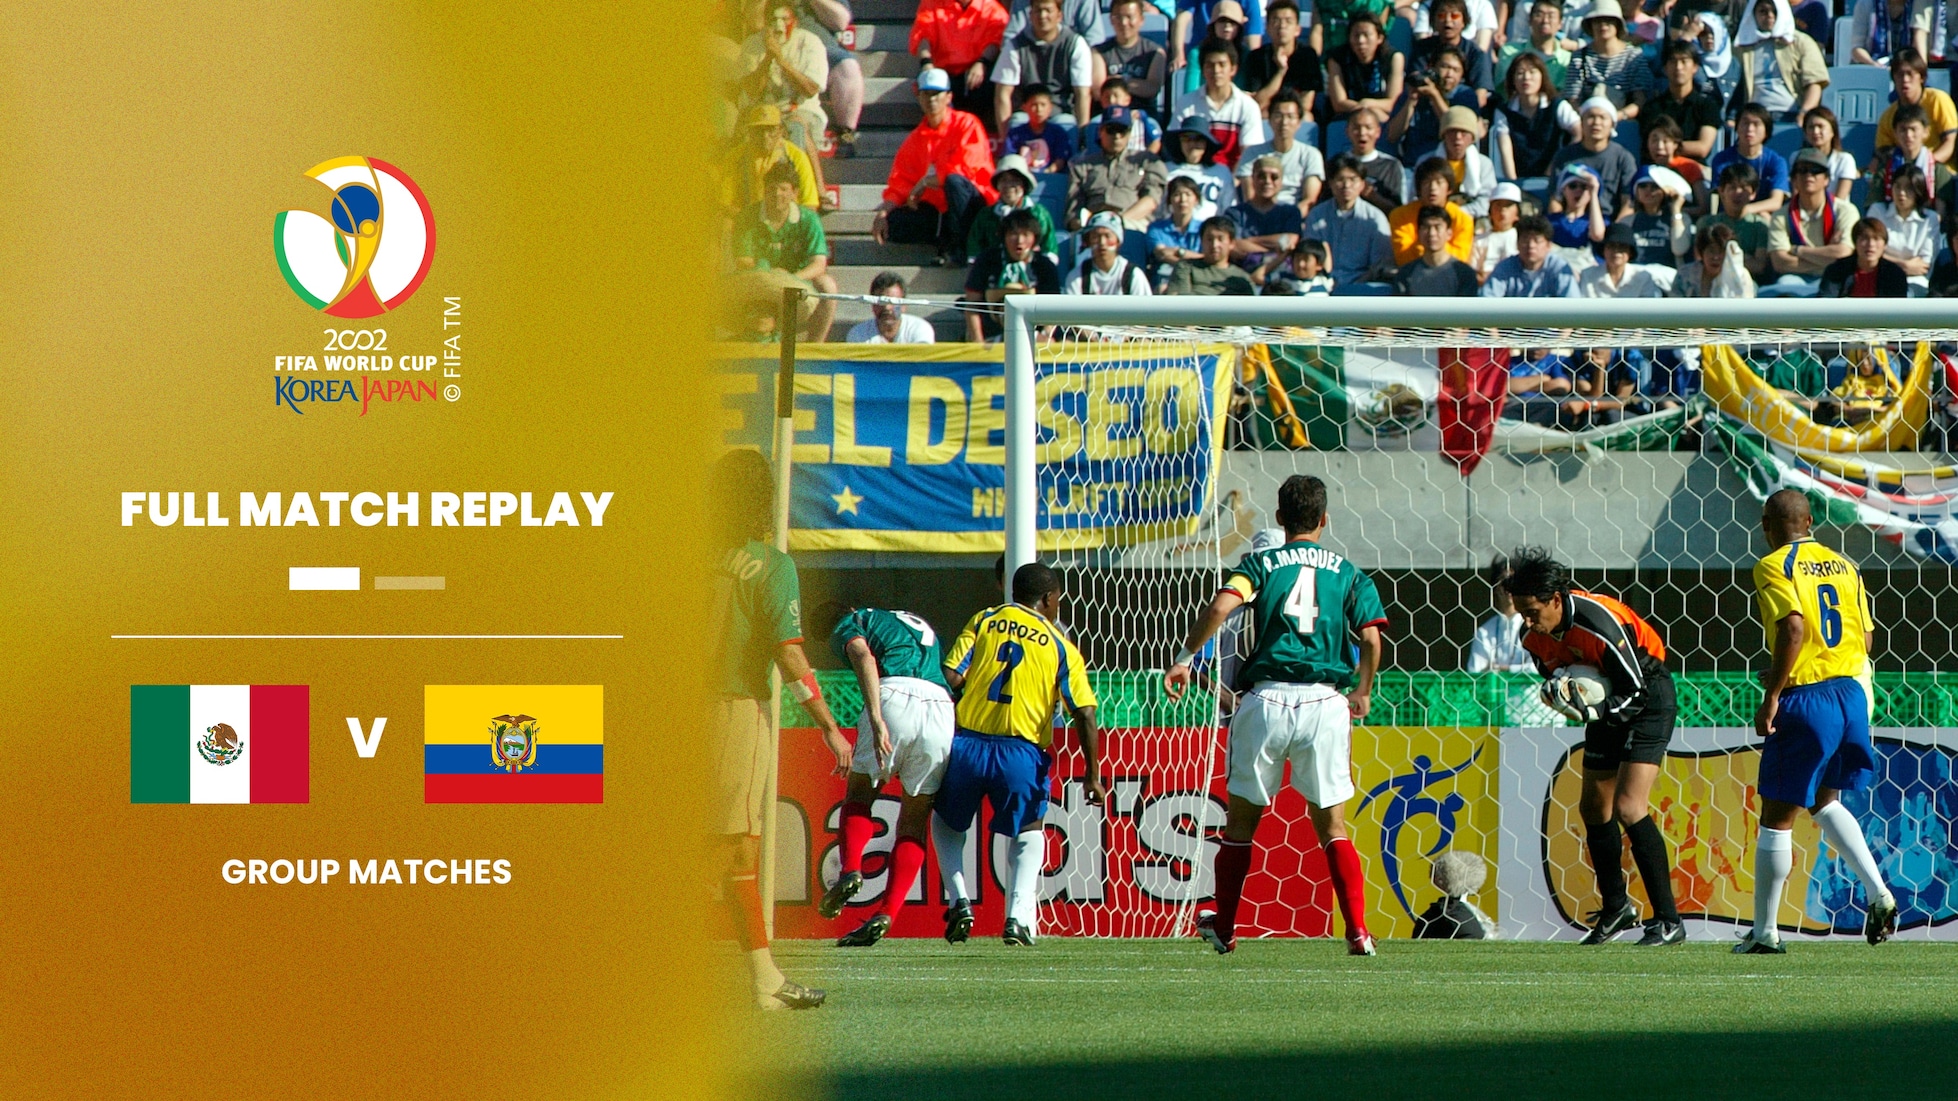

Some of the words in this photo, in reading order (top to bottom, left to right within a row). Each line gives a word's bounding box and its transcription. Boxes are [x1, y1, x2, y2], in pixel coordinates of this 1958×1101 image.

[1283, 566, 1320, 634] 4
[1817, 583, 1843, 648] 6
[987, 618, 1050, 647] POROZO
[987, 640, 1025, 704] 2
